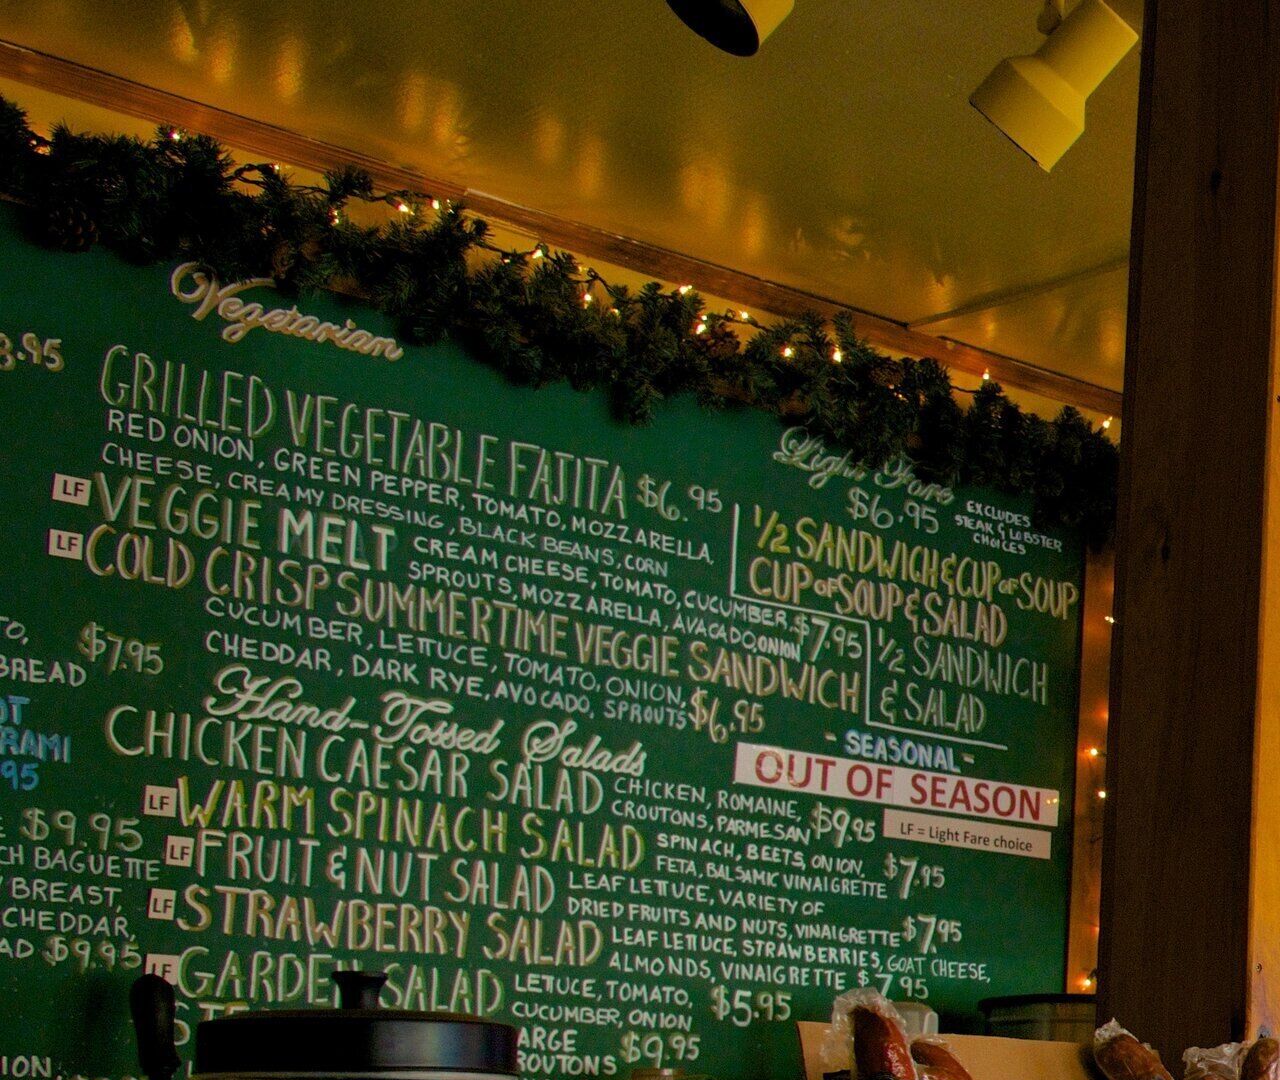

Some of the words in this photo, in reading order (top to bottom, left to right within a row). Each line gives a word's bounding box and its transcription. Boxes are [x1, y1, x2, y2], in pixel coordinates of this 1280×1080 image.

[171, 261, 403, 361] Vegetarian
[102, 344, 274, 438] GRILLED
[286, 389, 498, 490] VEGETABLE
[510, 440, 626, 520] FAJITA
[62, 478, 85, 497] LF
[94, 472, 262, 550] VEGGIE
[278, 506, 397, 572] MELT
[102, 442, 220, 490] CHEESE,
[227, 471, 325, 507] CREAMY
[624, 553, 669, 578] CORN
[108, 409, 166, 443] RED
[174, 424, 263, 471] ONION,
[274, 449, 362, 487] GREEN
[372, 471, 466, 513] PEPPER,
[473, 493, 567, 531] TOMATO,
[572, 515, 715, 567] MOZZARELLA,
[847, 486, 940, 535] $6.95
[966, 500, 1032, 529] EXCLUDES
[413, 536, 499, 568] CREAM
[505, 553, 598, 590] CHEESE,
[600, 571, 681, 611] TOMATO,
[521, 584, 668, 632] MOZZARELLA,
[749, 556, 813, 604] CUP
[56, 537, 79, 556] LF
[86, 522, 195, 588] COLD
[205, 545, 332, 608] CRISP
[336, 570, 570, 660] SUMMERTIME
[574, 621, 681, 679] VEGGIE
[687, 640, 861, 714] SANDWICH
[78, 620, 165, 676] $7.95
[913, 636, 1049, 706] SANDWICH
[205, 663, 504, 754] Hand-Tossed
[522, 719, 648, 777] Salads
[904, 686, 985, 734] SALAD
[105, 704, 306, 779] CHICKEN
[316, 733, 471, 800] CAESAR
[487, 758, 604, 816] SALAD
[754, 750, 836, 793] OUT
[846, 763, 894, 801] OF
[909, 772, 1043, 822] SEASON
[843, 729, 962, 774] SEASONAL
[149, 794, 170, 811] LF
[177, 774, 316, 836] WARM
[326, 786, 508, 855] SPINACH
[519, 811, 645, 872] SALAD
[810, 800, 877, 848] $9.95
[899, 821, 914, 837] LF
[928, 824, 964, 846] Light
[963, 830, 991, 848] Fare
[993, 835, 1033, 853] choice
[169, 843, 191, 861] LF
[196, 828, 321, 887] FRUIT
[355, 847, 440, 902] NUT
[445, 856, 556, 914] SALAD
[882, 851, 946, 901] $7.95
[151, 895, 172, 914] LF
[176, 883, 471, 960] STRAWBERRY
[482, 910, 605, 968] SALAD
[711, 984, 793, 1028] $5.95
